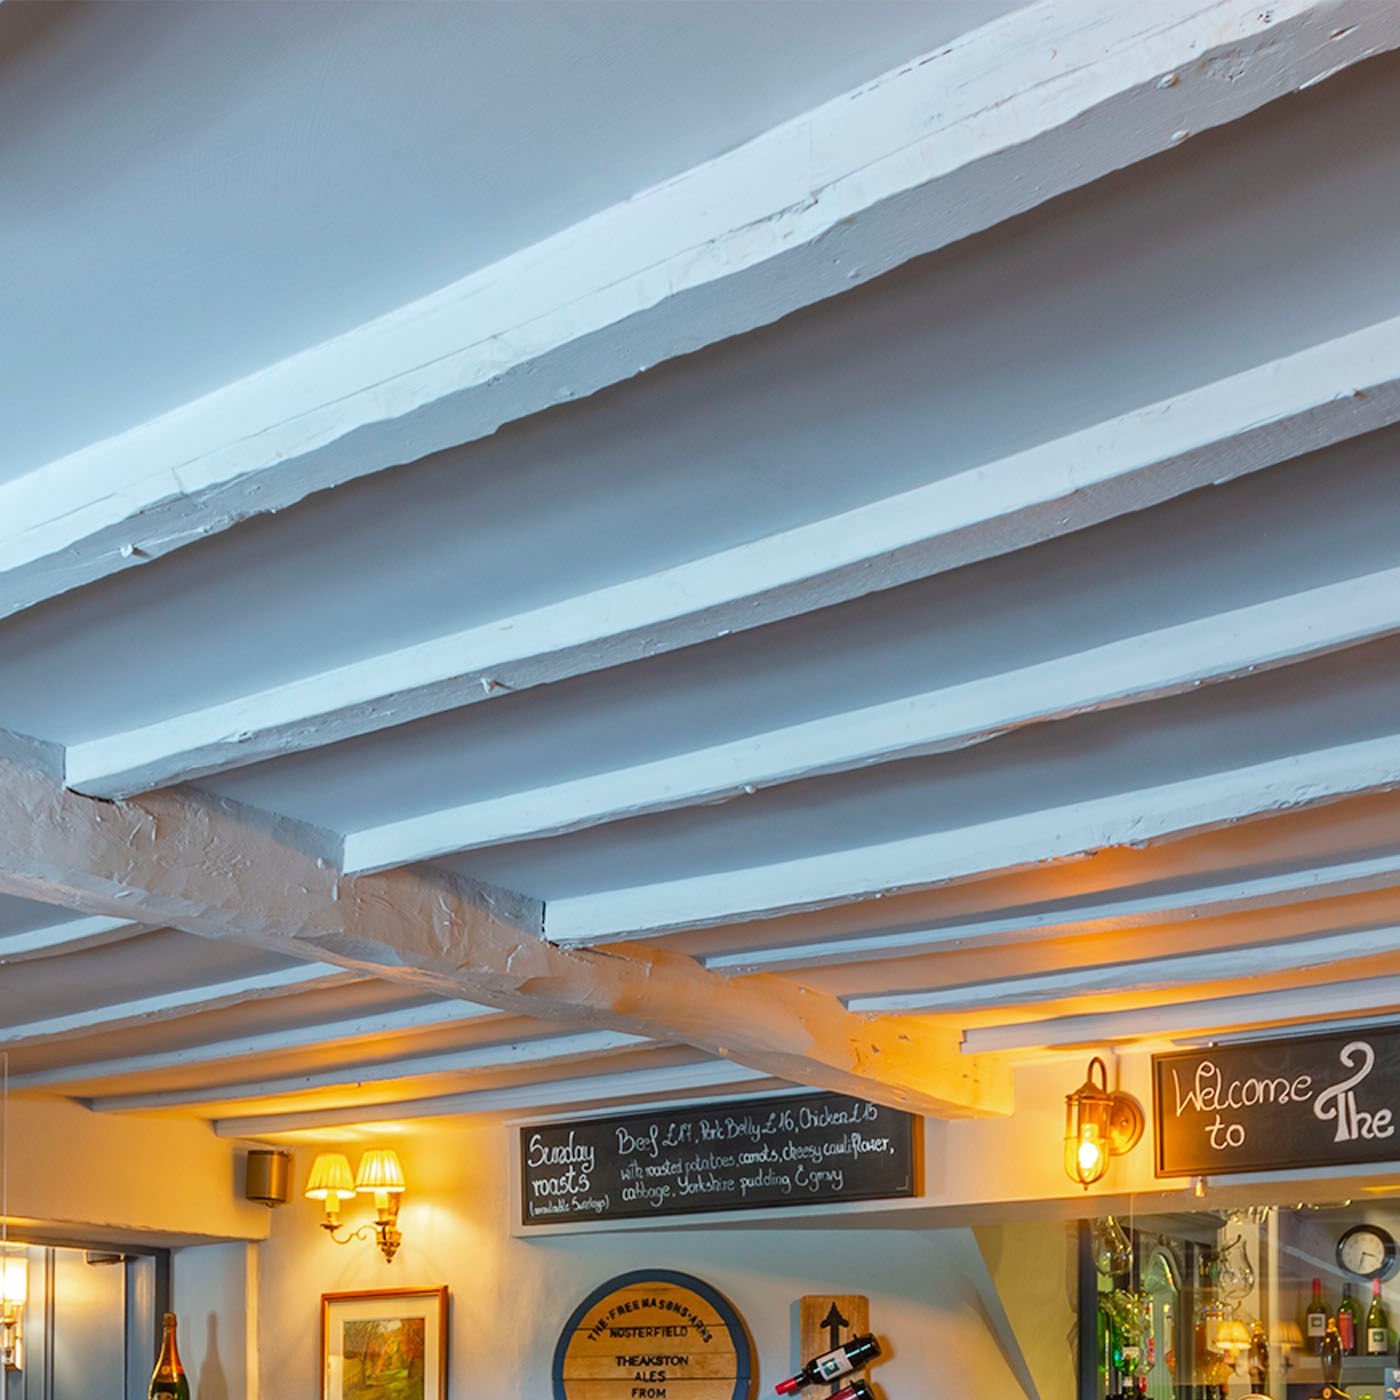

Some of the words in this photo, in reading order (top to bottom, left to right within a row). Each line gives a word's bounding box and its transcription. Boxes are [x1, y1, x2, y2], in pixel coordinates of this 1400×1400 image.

[1172, 1060, 1313, 1117] Welcome
[1313, 1040, 1395, 1142] The
[615, 1124, 659, 1158] Beef
[724, 1116, 761, 1143] Belly
[799, 1105, 849, 1129] Chicken
[1204, 1113, 1245, 1150] to
[527, 1130, 595, 1173] Sunday
[620, 1159, 643, 1181] with
[645, 1158, 683, 1177] roasted
[782, 1139, 823, 1164] cheesy
[532, 1165, 591, 1197] roasts
[677, 1172, 735, 1195] Yorkshire
[739, 1168, 791, 1197] pudding
[809, 1168, 843, 1193] gravy
[587, 1317, 609, 1343] THE
[609, 1297, 689, 1319] FREEMASONS
[689, 1314, 713, 1344] ARMS
[609, 1326, 689, 1338] NOSTERFIELD
[615, 1355, 689, 1367] THEAKSTON
[634, 1371, 667, 1383] ALES
[631, 1388, 667, 1399] FROM
